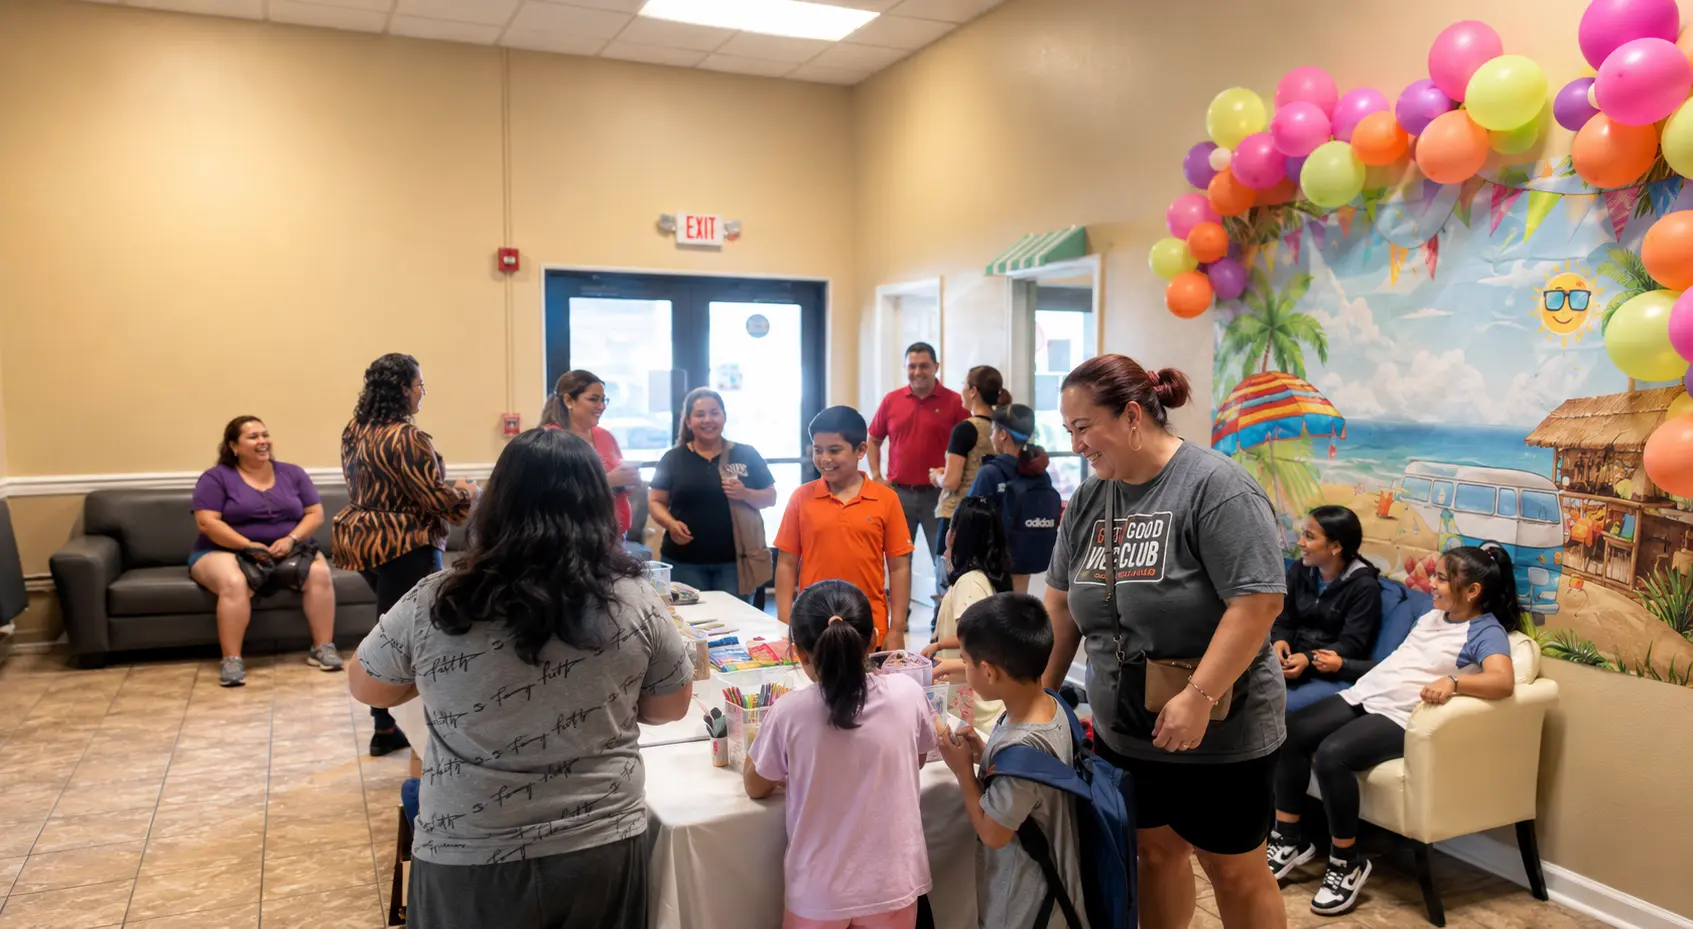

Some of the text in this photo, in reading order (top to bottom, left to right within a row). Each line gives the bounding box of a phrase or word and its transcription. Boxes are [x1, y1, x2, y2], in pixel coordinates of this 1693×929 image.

[686, 215, 716, 240] EXIT
[1025, 518, 1054, 528] adidas
[1126, 520, 1164, 539] GOOD
[1119, 541, 1159, 569] CLUB
